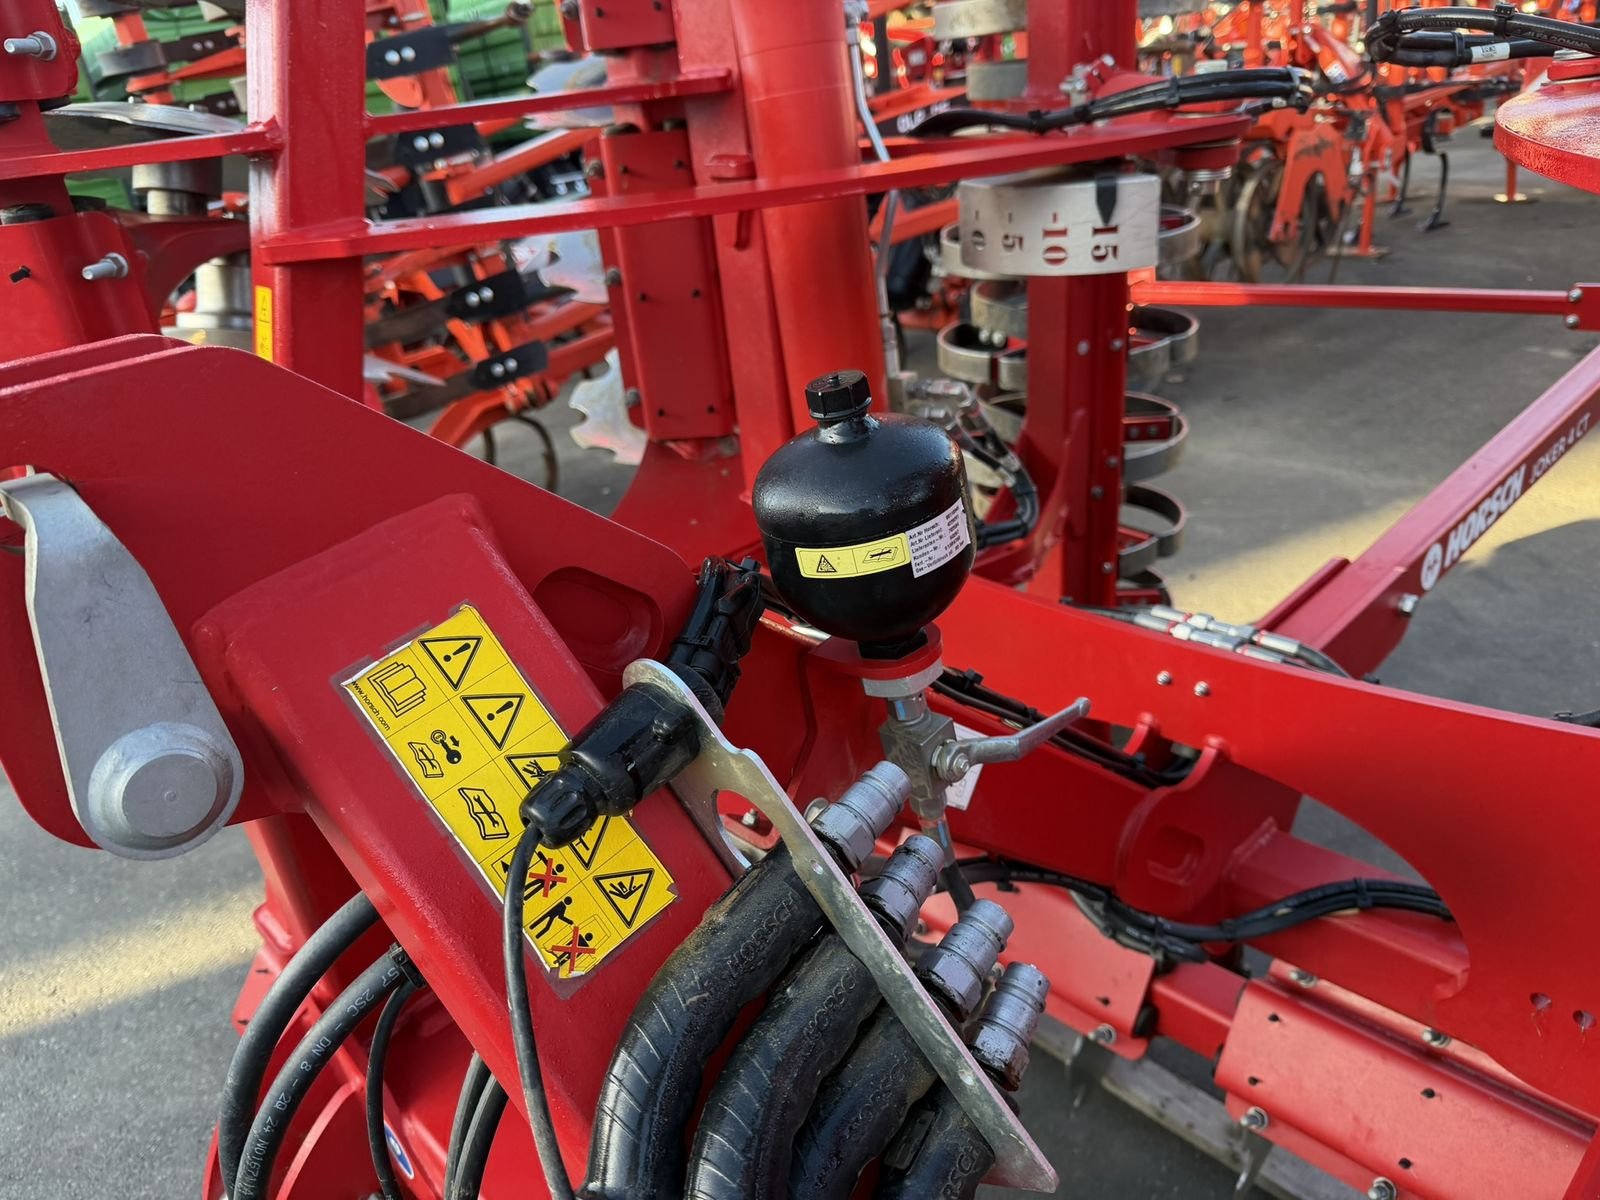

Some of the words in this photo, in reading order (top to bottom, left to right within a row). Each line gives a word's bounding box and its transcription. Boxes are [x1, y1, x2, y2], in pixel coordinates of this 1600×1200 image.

[1002, 233, 1023, 252] 5
[1042, 226, 1070, 266] 10
[1092, 224, 1119, 263] 15
[1530, 438, 1566, 484] JOKER
[1576, 412, 1592, 436] CT
[381, 967, 400, 988] 57
[346, 990, 375, 1017] 2SC
[311, 1036, 332, 1058] DN
[299, 1061, 312, 1073] 8
[262, 1116, 280, 1134] 24
